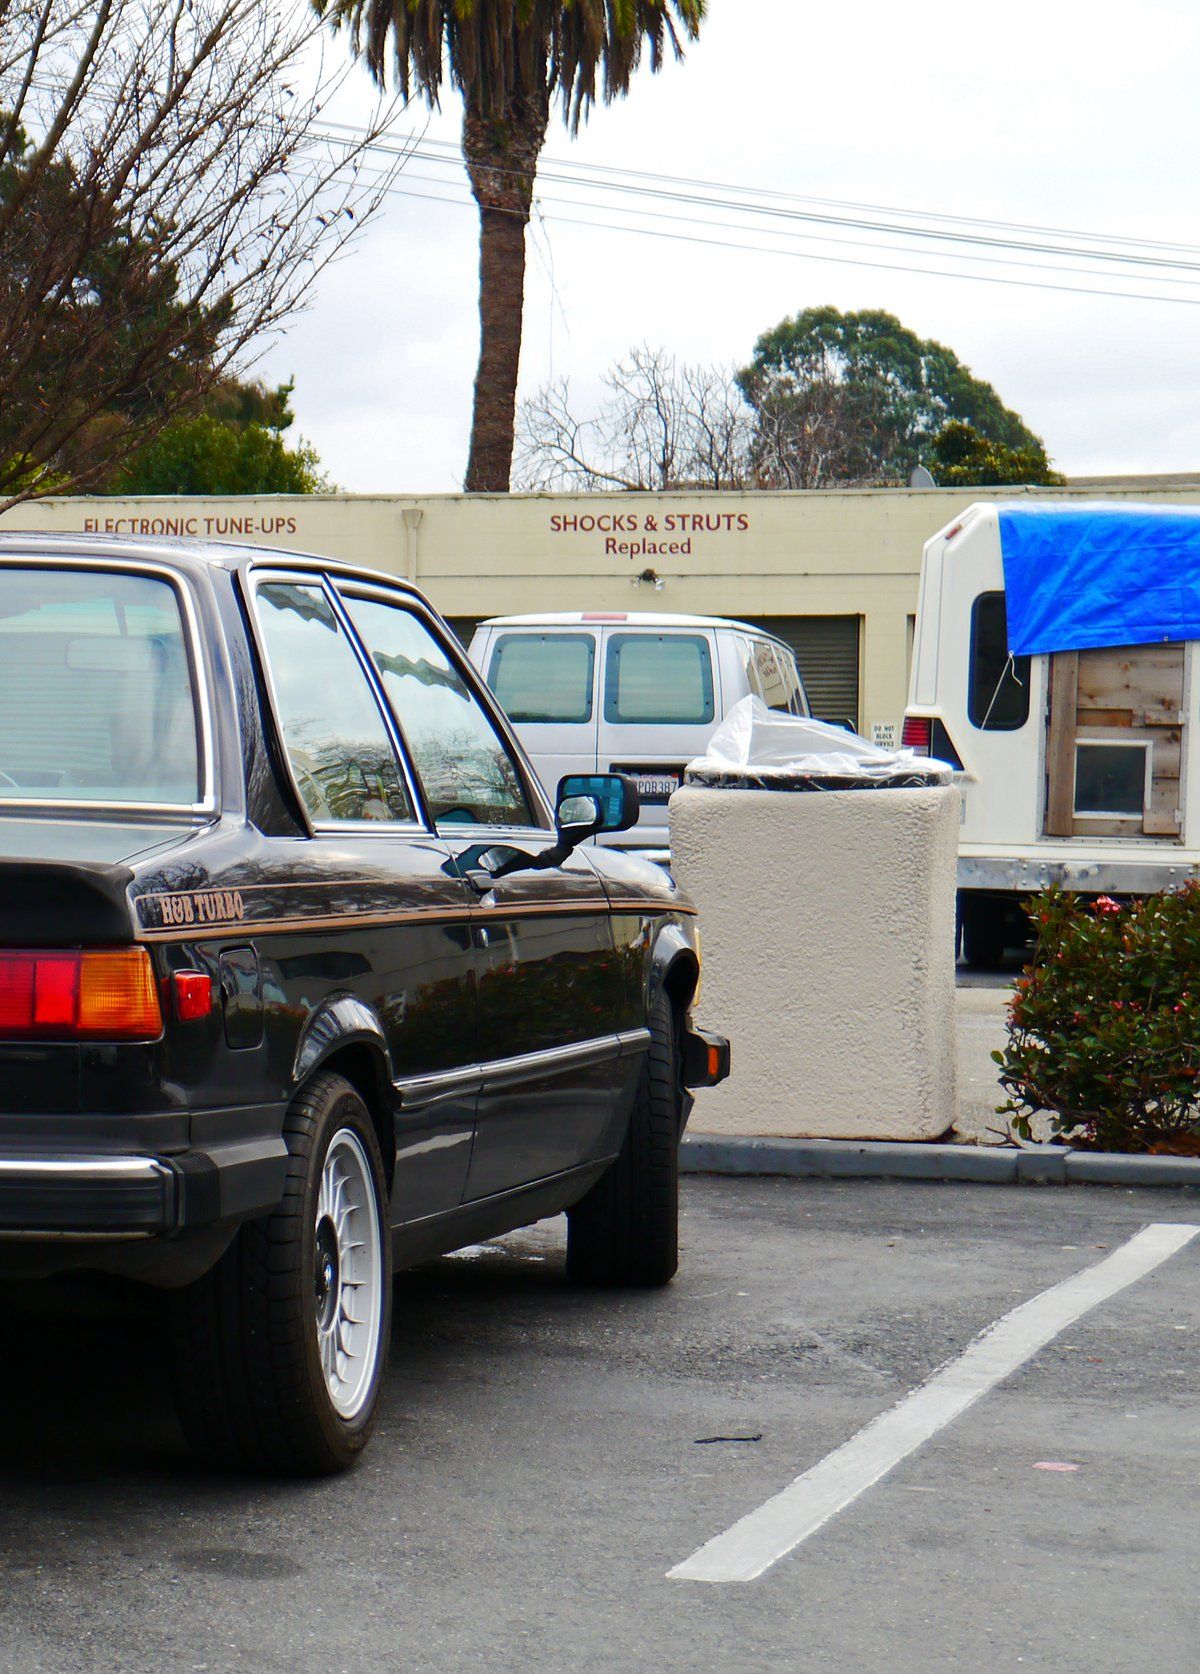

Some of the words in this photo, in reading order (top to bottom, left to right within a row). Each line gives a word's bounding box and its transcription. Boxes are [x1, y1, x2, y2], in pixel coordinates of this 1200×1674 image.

[84, 518, 198, 536] ELECTRONIC
[203, 517, 297, 535] TUNE-UPS
[550, 514, 637, 532] SHOCKS
[643, 514, 658, 532] &
[664, 513, 749, 532] STRUTS
[605, 537, 691, 559] Replaced
[195, 891, 244, 921] TURBO
